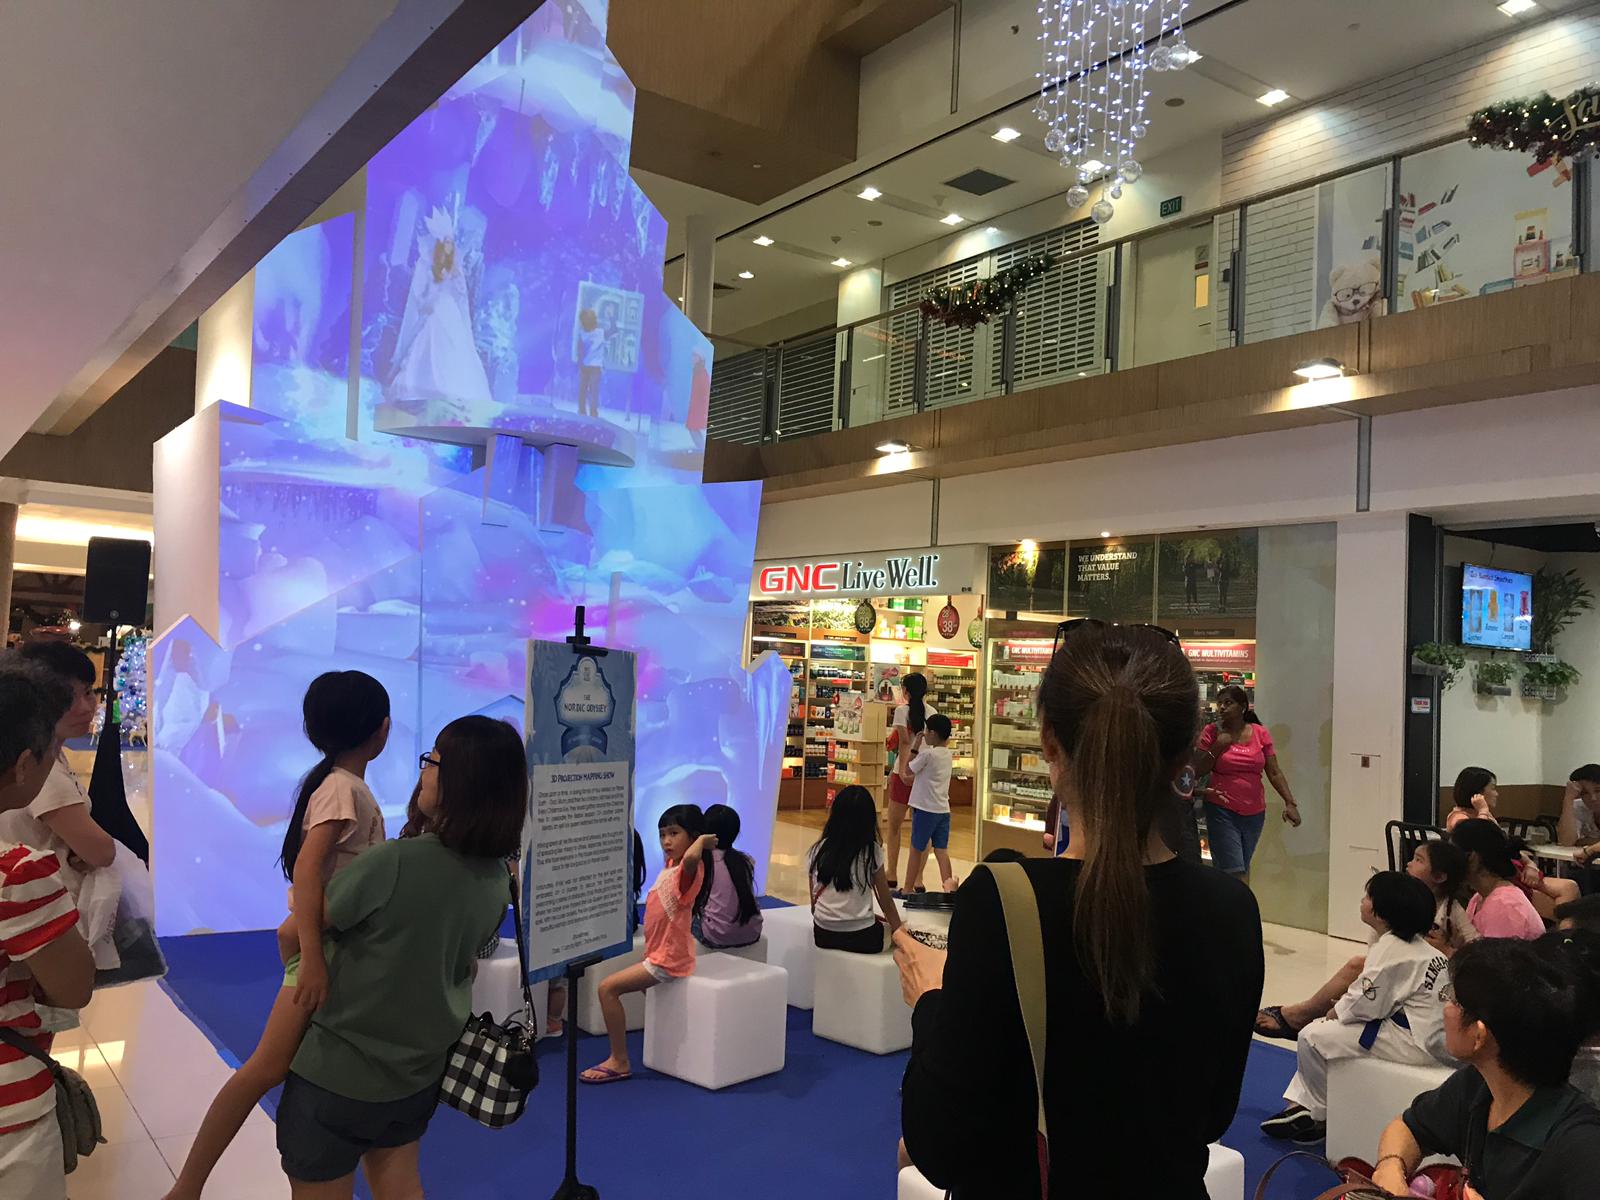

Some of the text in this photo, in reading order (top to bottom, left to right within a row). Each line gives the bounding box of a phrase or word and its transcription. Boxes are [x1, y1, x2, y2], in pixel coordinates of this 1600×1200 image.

[1161, 198, 1180, 214] EXIT
[1090, 552, 1138, 562] UNDERSTAND
[1097, 563, 1120, 571] VALUE
[759, 563, 838, 593] GNC
[1077, 573, 1111, 582] MATTERS.
[859, 616, 870, 628] 38
[942, 620, 953, 632] 38
[1188, 649, 1249, 659] GNC MULTIVITAMINS
[564, 703, 608, 713] NORDIC ODYSSEY
[558, 773, 582, 783] PROJECTION
[583, 772, 602, 782] MAPPING
